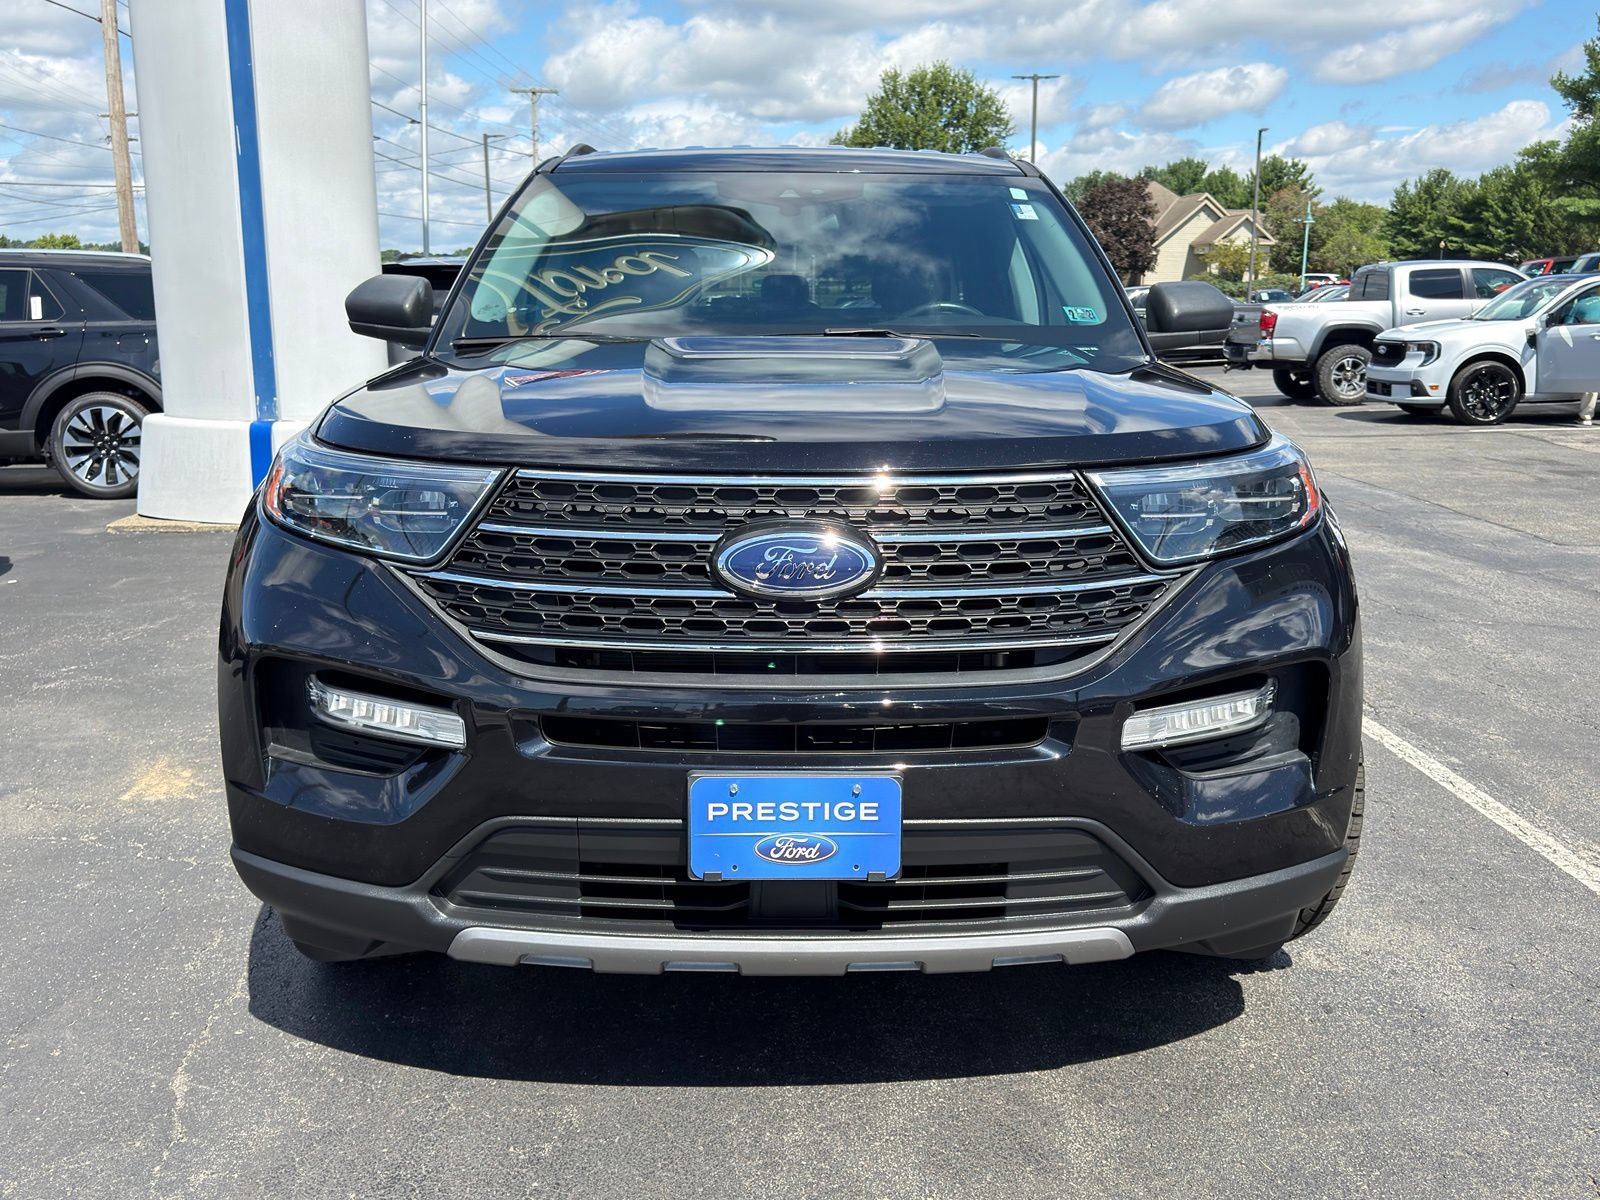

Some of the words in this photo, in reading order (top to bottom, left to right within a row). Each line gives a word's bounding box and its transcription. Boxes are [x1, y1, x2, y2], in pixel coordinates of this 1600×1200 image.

[755, 545, 838, 580] Ford
[707, 802, 880, 821] PRESTIGE
[770, 836, 820, 859] Ford
